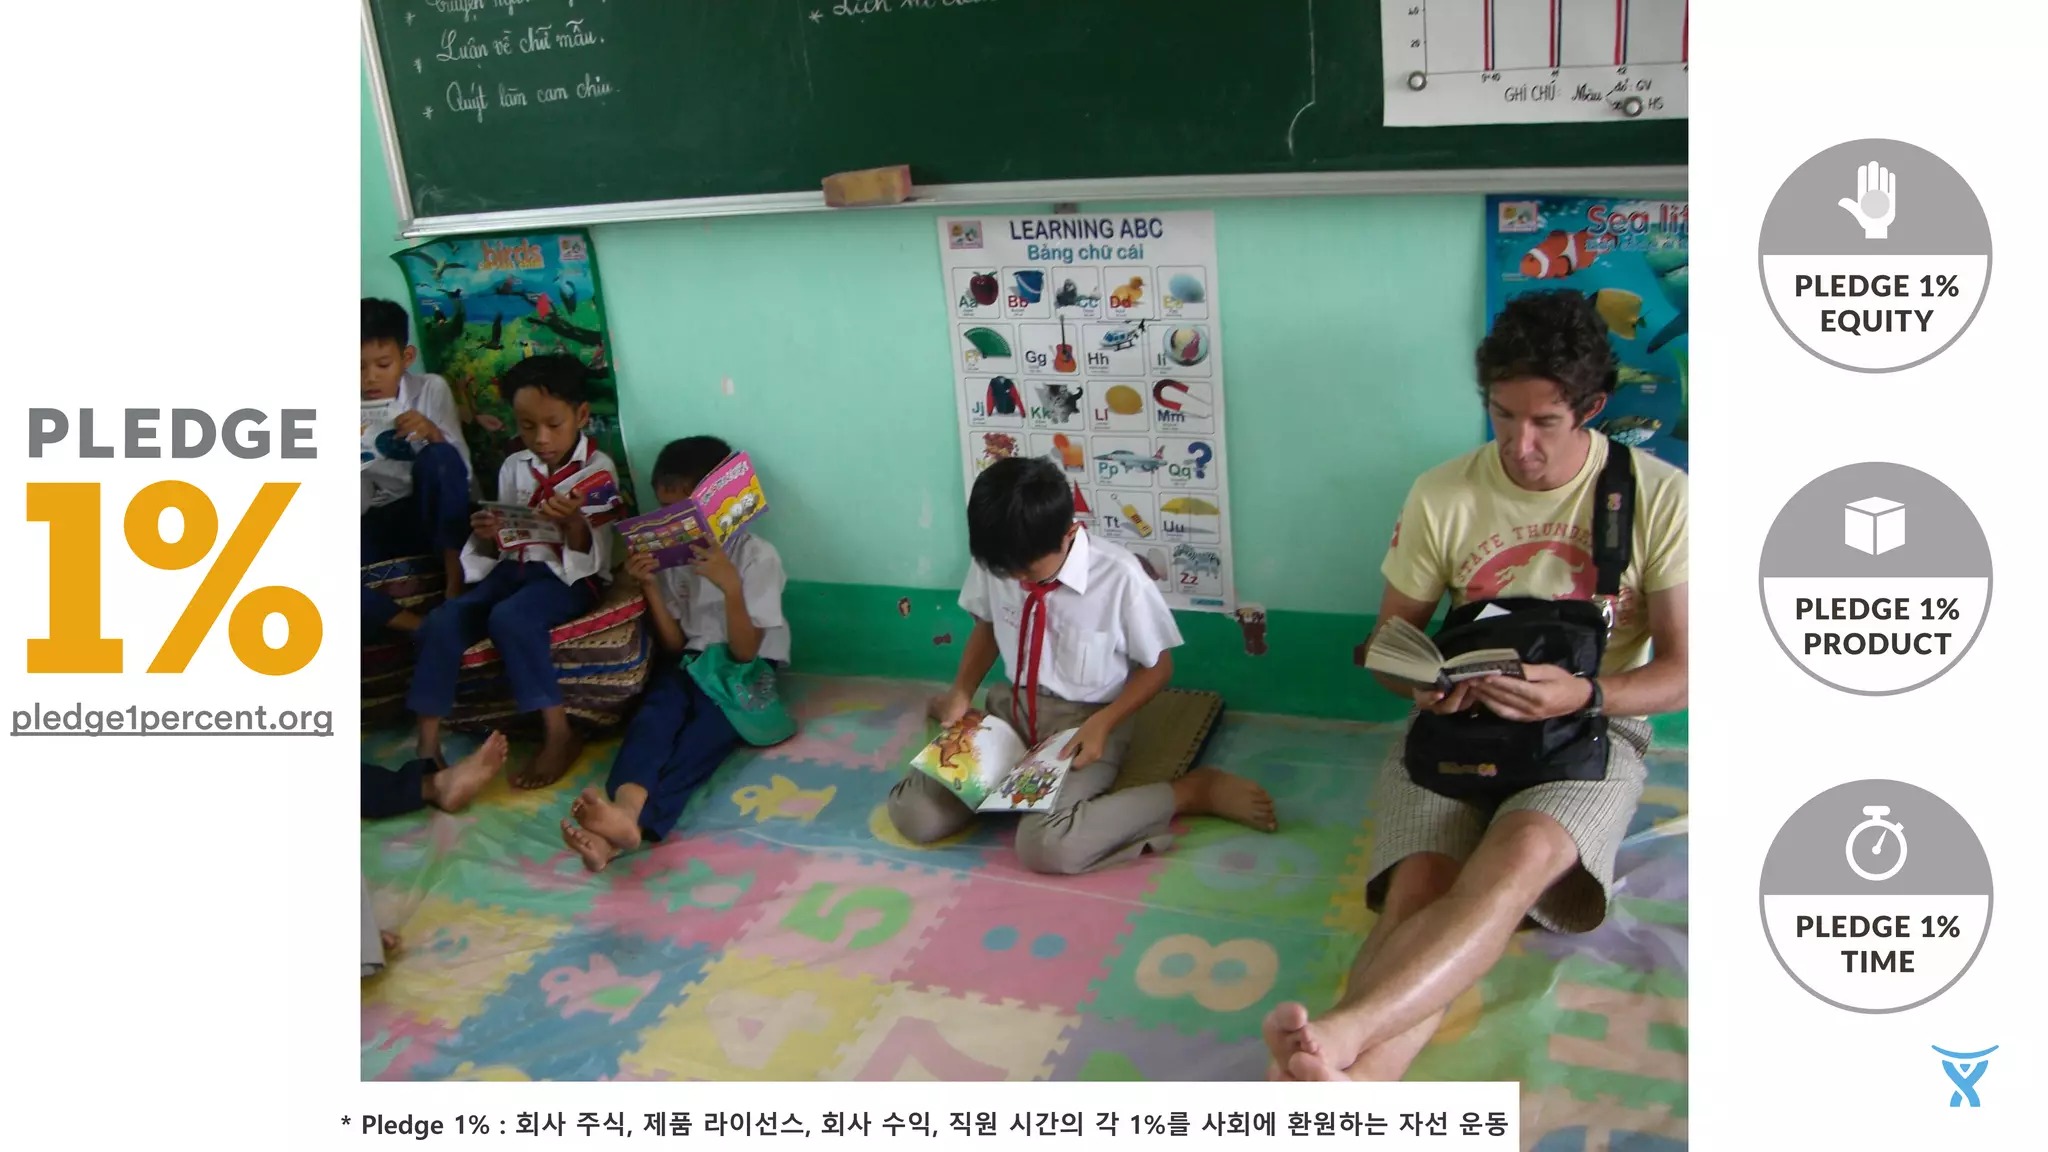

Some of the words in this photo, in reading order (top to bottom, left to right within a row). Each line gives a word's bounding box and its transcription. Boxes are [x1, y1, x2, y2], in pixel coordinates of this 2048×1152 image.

[1586, 203, 1651, 235] Sea
[1010, 219, 1114, 240] LEARNING
[1120, 218, 1164, 239] ABC
[481, 237, 545, 263] birds
[1008, 295, 1029, 308] Bb
[1110, 295, 1132, 308] Dd
[1025, 350, 1047, 366] Gg
[1087, 352, 1109, 365] Hh
[1157, 409, 1185, 423] Mm
[1098, 461, 1118, 479] Pp
[1104, 515, 1120, 529] Tt
[1163, 520, 1184, 533] Uu
[1180, 572, 1198, 585] Zz
